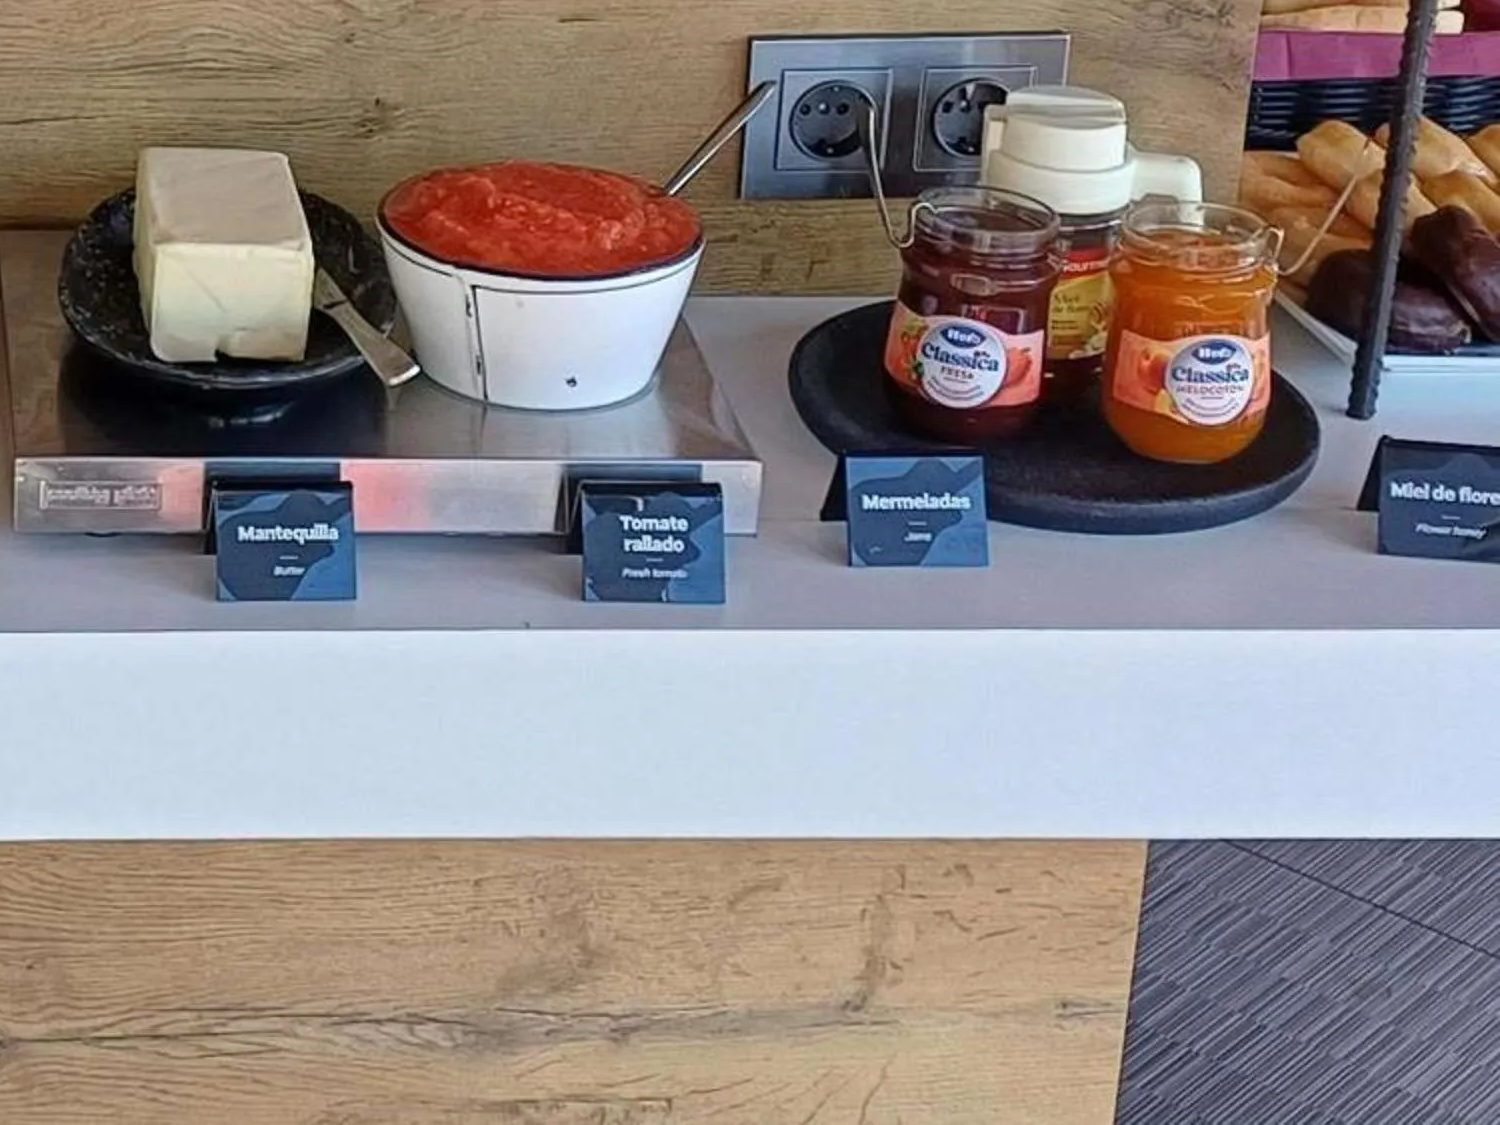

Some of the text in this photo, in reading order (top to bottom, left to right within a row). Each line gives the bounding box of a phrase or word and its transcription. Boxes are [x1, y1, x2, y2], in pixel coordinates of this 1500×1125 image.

[861, 492, 972, 510] Mermeladas
[1389, 481, 1500, 506] Miel de flore
[619, 514, 689, 532] Tomate
[237, 522, 339, 545] Mantequilla
[623, 535, 685, 553] rallado
